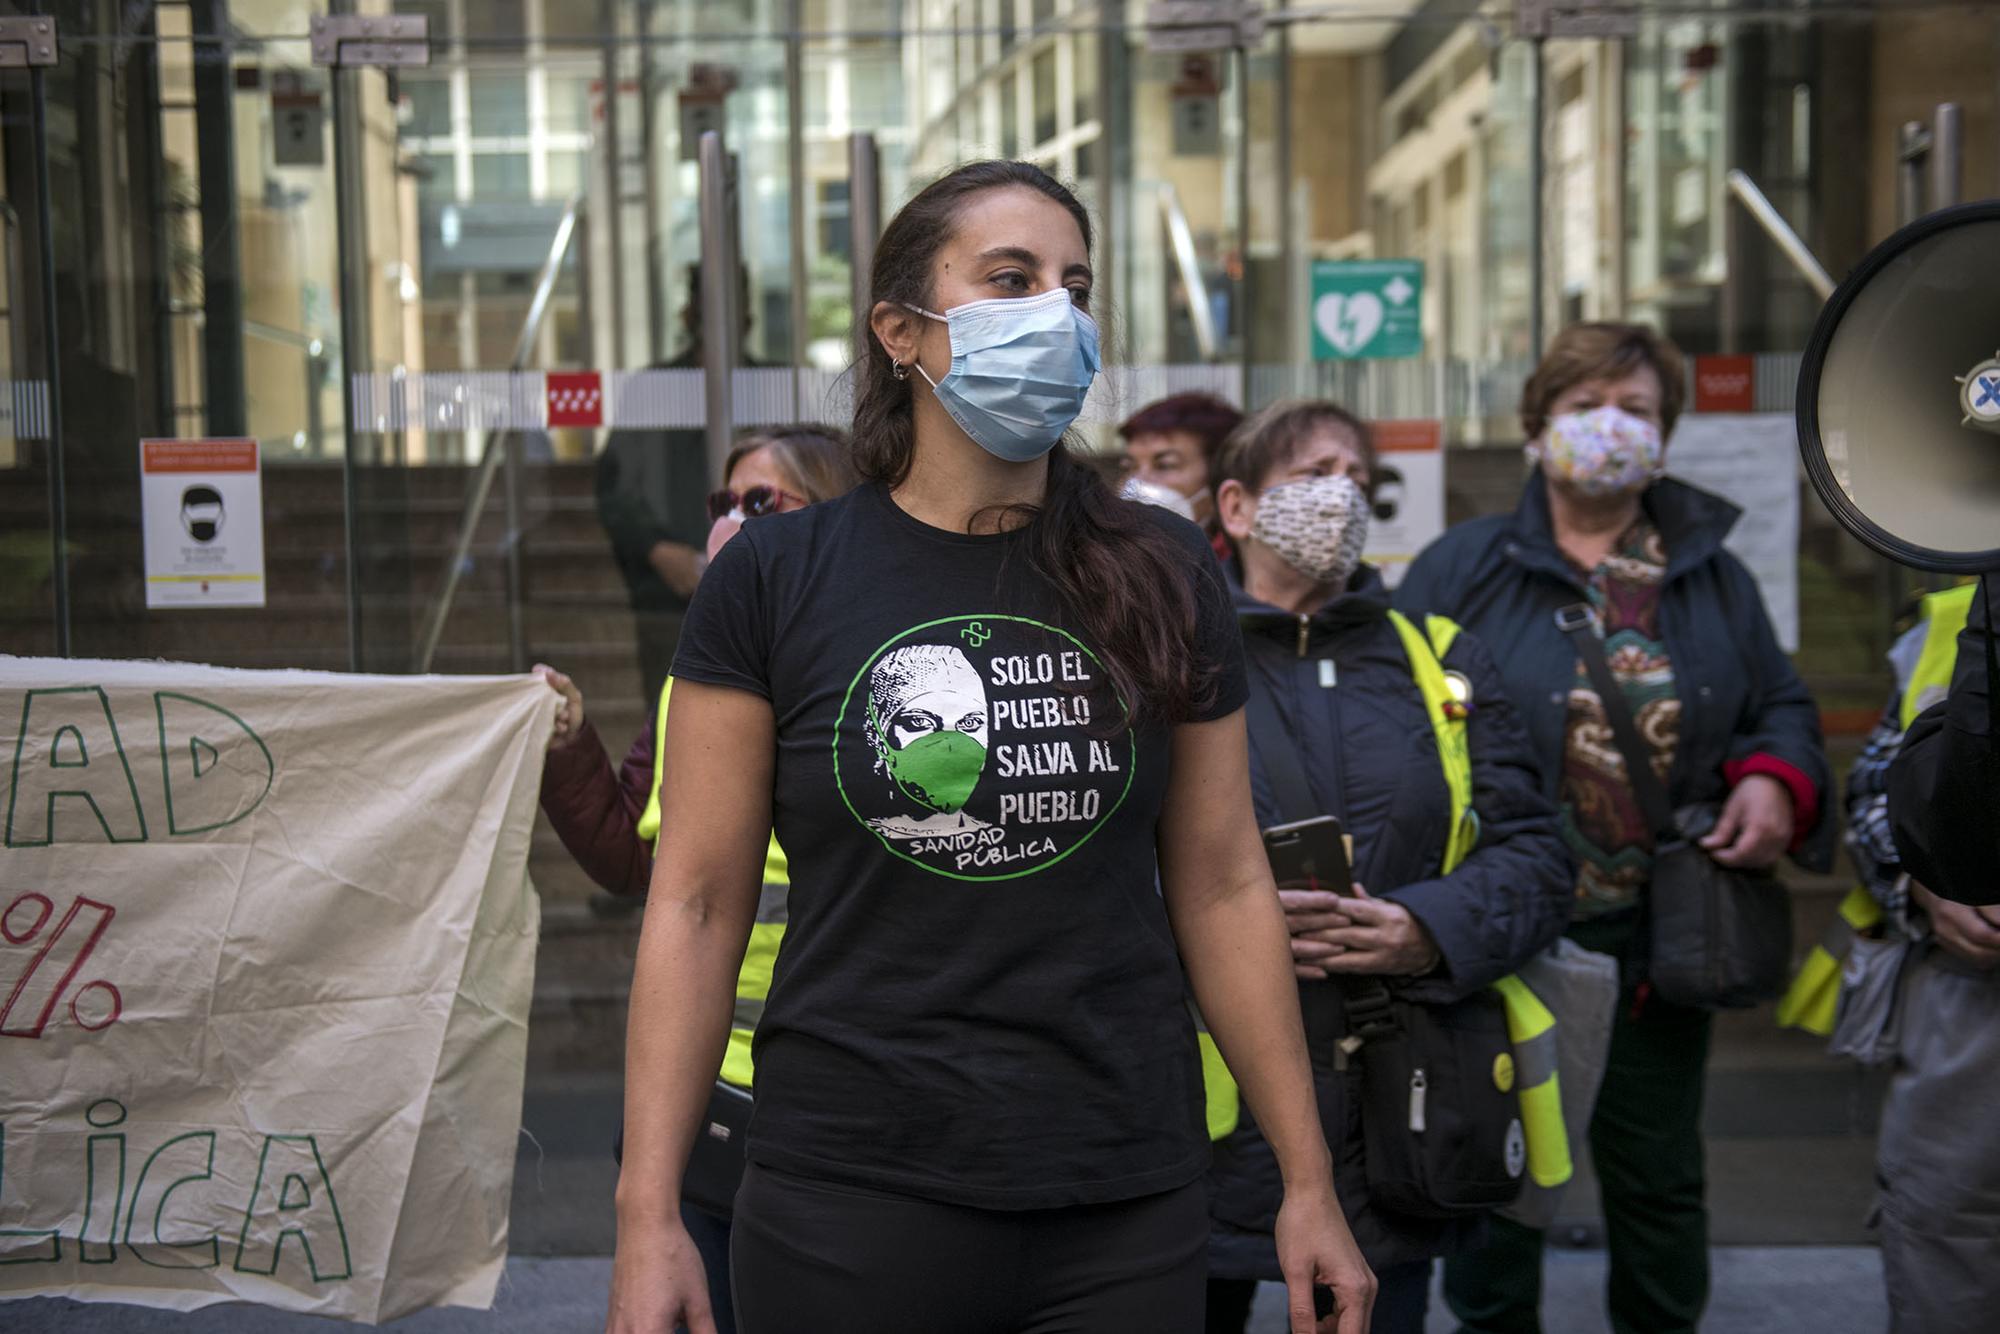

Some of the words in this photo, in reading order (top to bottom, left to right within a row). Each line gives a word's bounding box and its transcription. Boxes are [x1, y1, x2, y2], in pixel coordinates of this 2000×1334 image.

[991, 653, 1053, 686] SOLO
[1060, 652, 1091, 681] EL
[993, 695, 1091, 731] PUEBLO
[4, 685, 274, 848] AD
[996, 742, 1078, 777] SALVA
[1088, 740, 1119, 773] AL
[999, 789, 1100, 825] PUEBLO
[910, 827, 1005, 855] SANIDAD
[955, 836, 1057, 870] PÚBLICA
